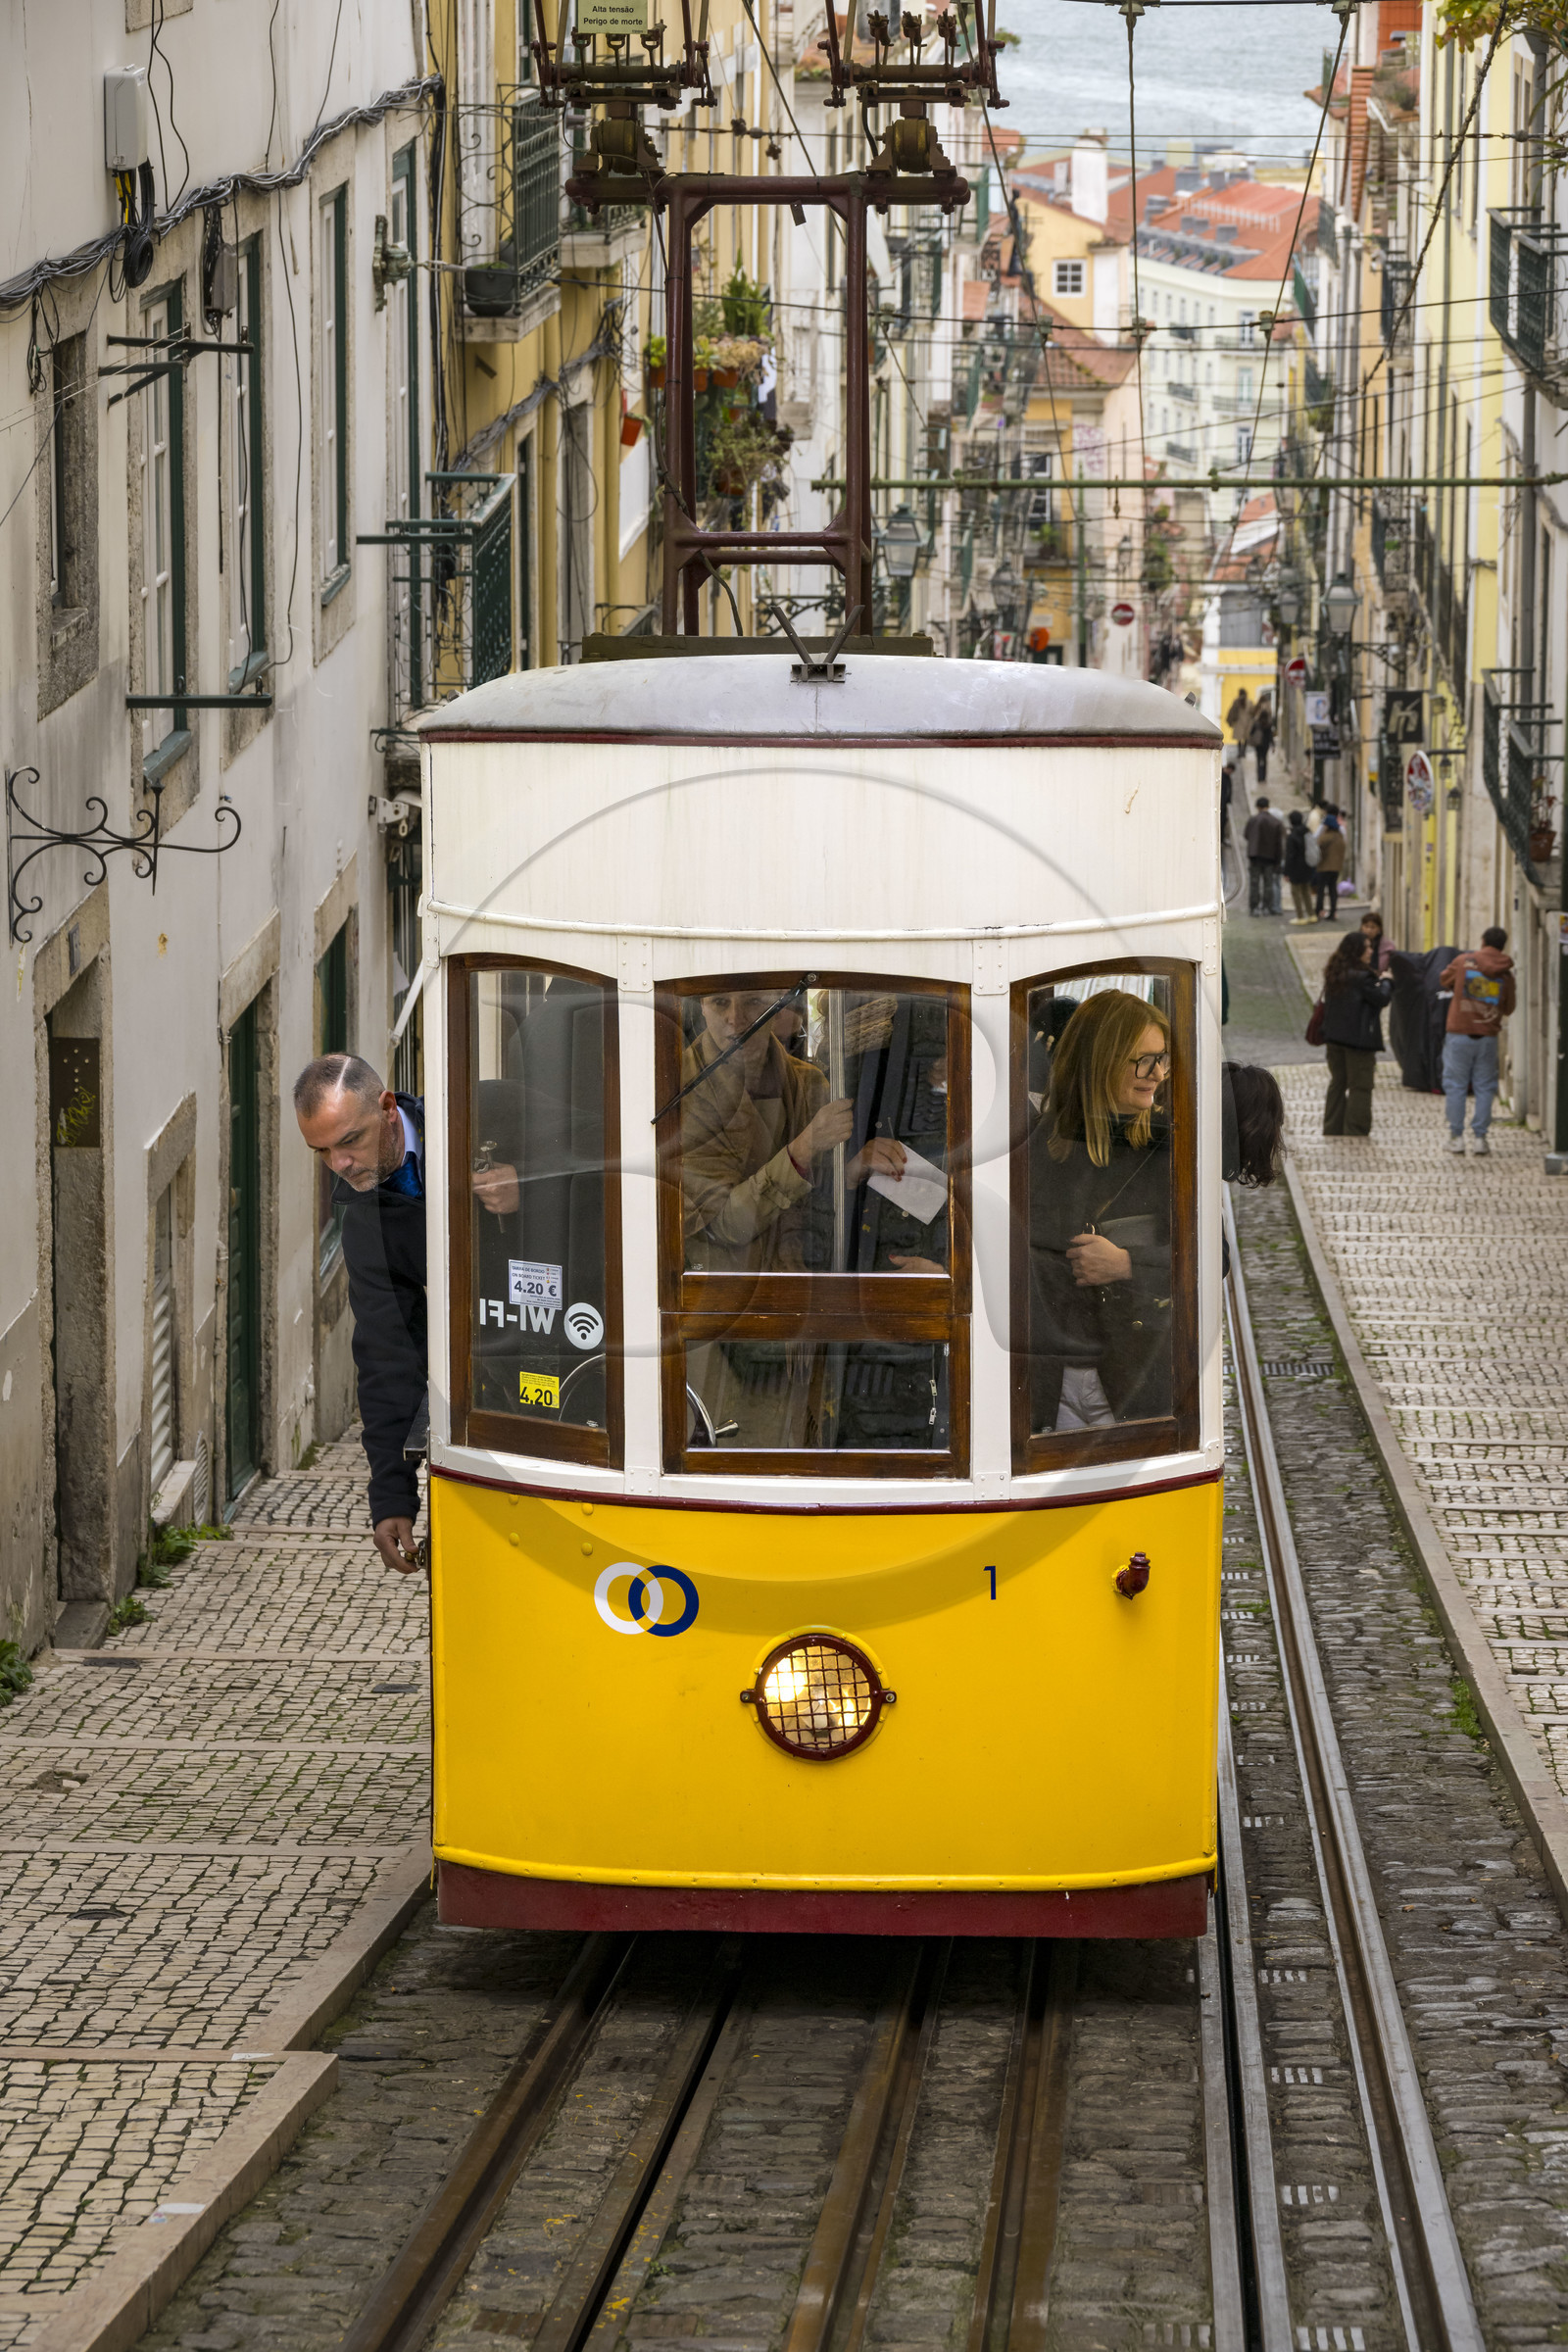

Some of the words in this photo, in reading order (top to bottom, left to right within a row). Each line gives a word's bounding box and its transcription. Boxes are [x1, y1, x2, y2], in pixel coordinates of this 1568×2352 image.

[584, 17, 608, 25] Perigo
[514, 1280, 543, 1295] 4.20
[548, 1285, 557, 1297] €
[983, 1566, 996, 1600] 1
